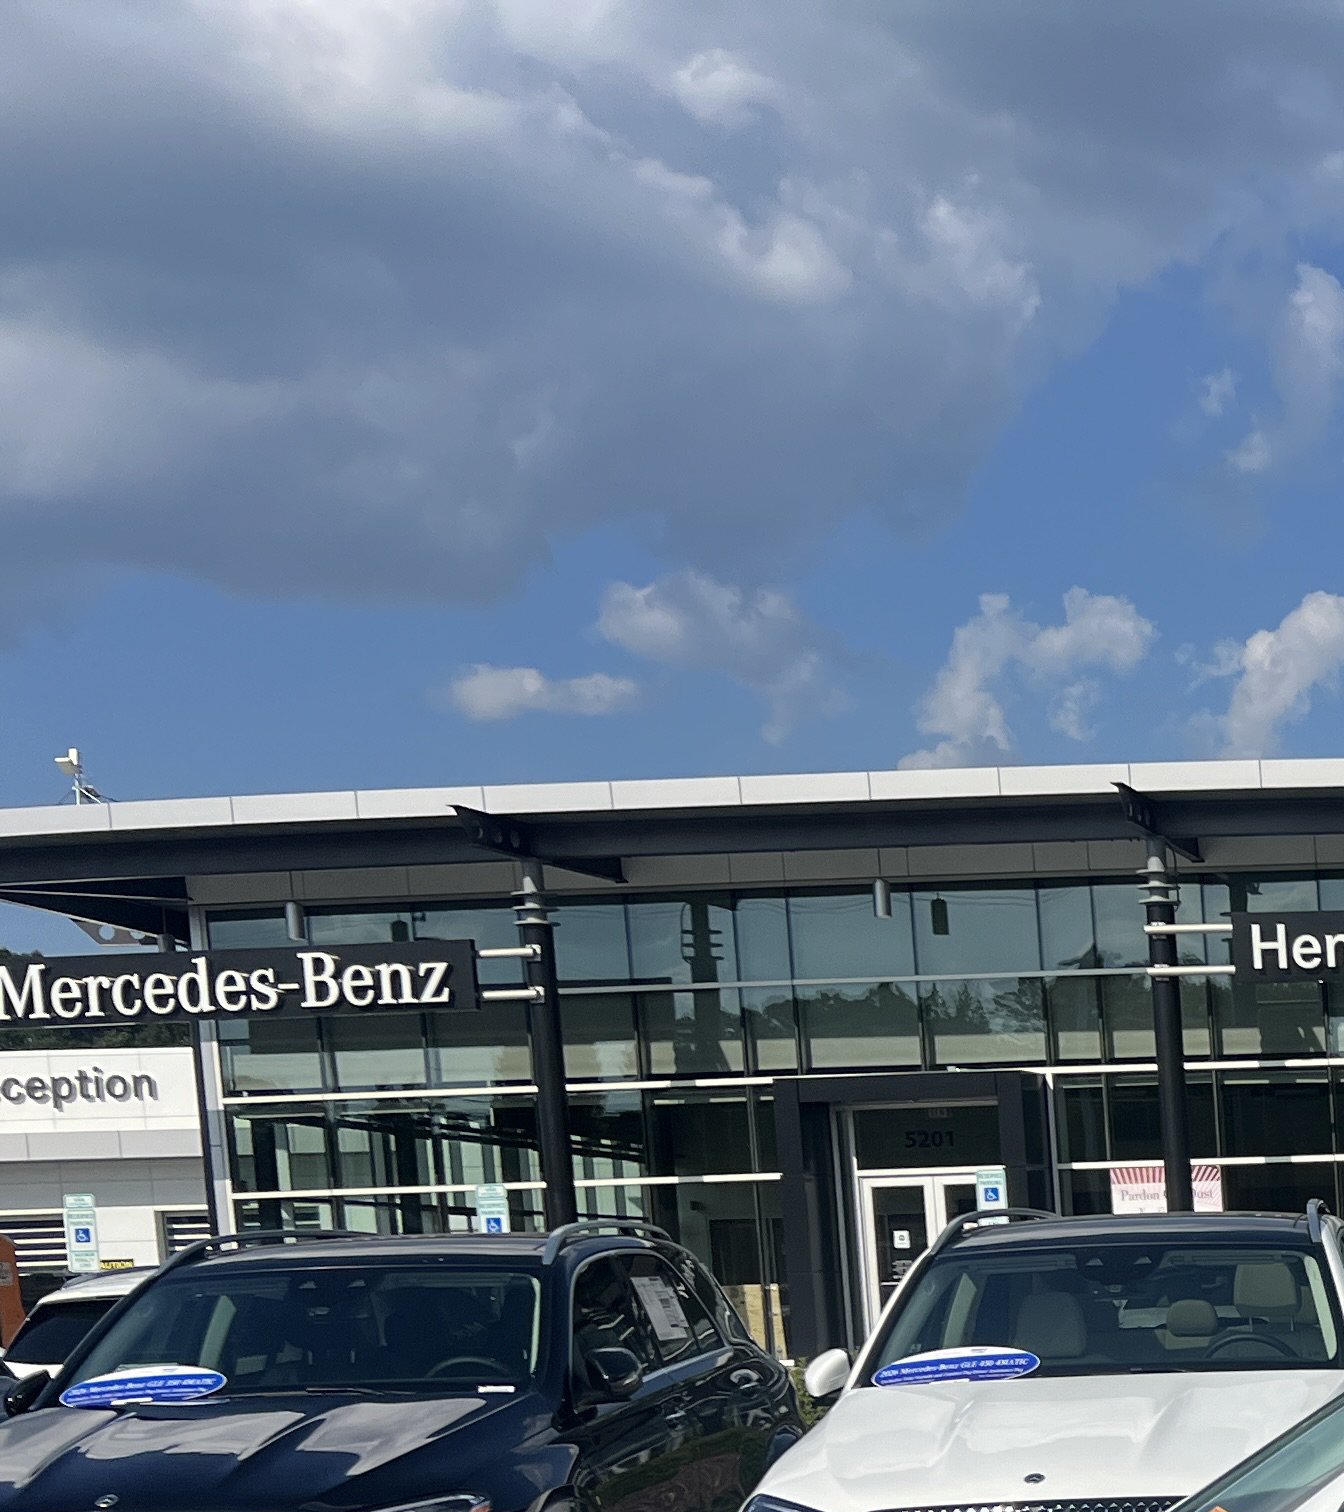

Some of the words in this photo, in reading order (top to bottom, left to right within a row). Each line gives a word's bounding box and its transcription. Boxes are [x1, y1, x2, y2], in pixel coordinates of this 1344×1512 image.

[0, 952, 452, 1020] Mercedes-Benz
[0, 1066, 158, 1112] ception
[904, 1130, 954, 1148] 5201
[1121, 1189, 1160, 1201] Pardon
[100, 1261, 133, 1270] AUTION
